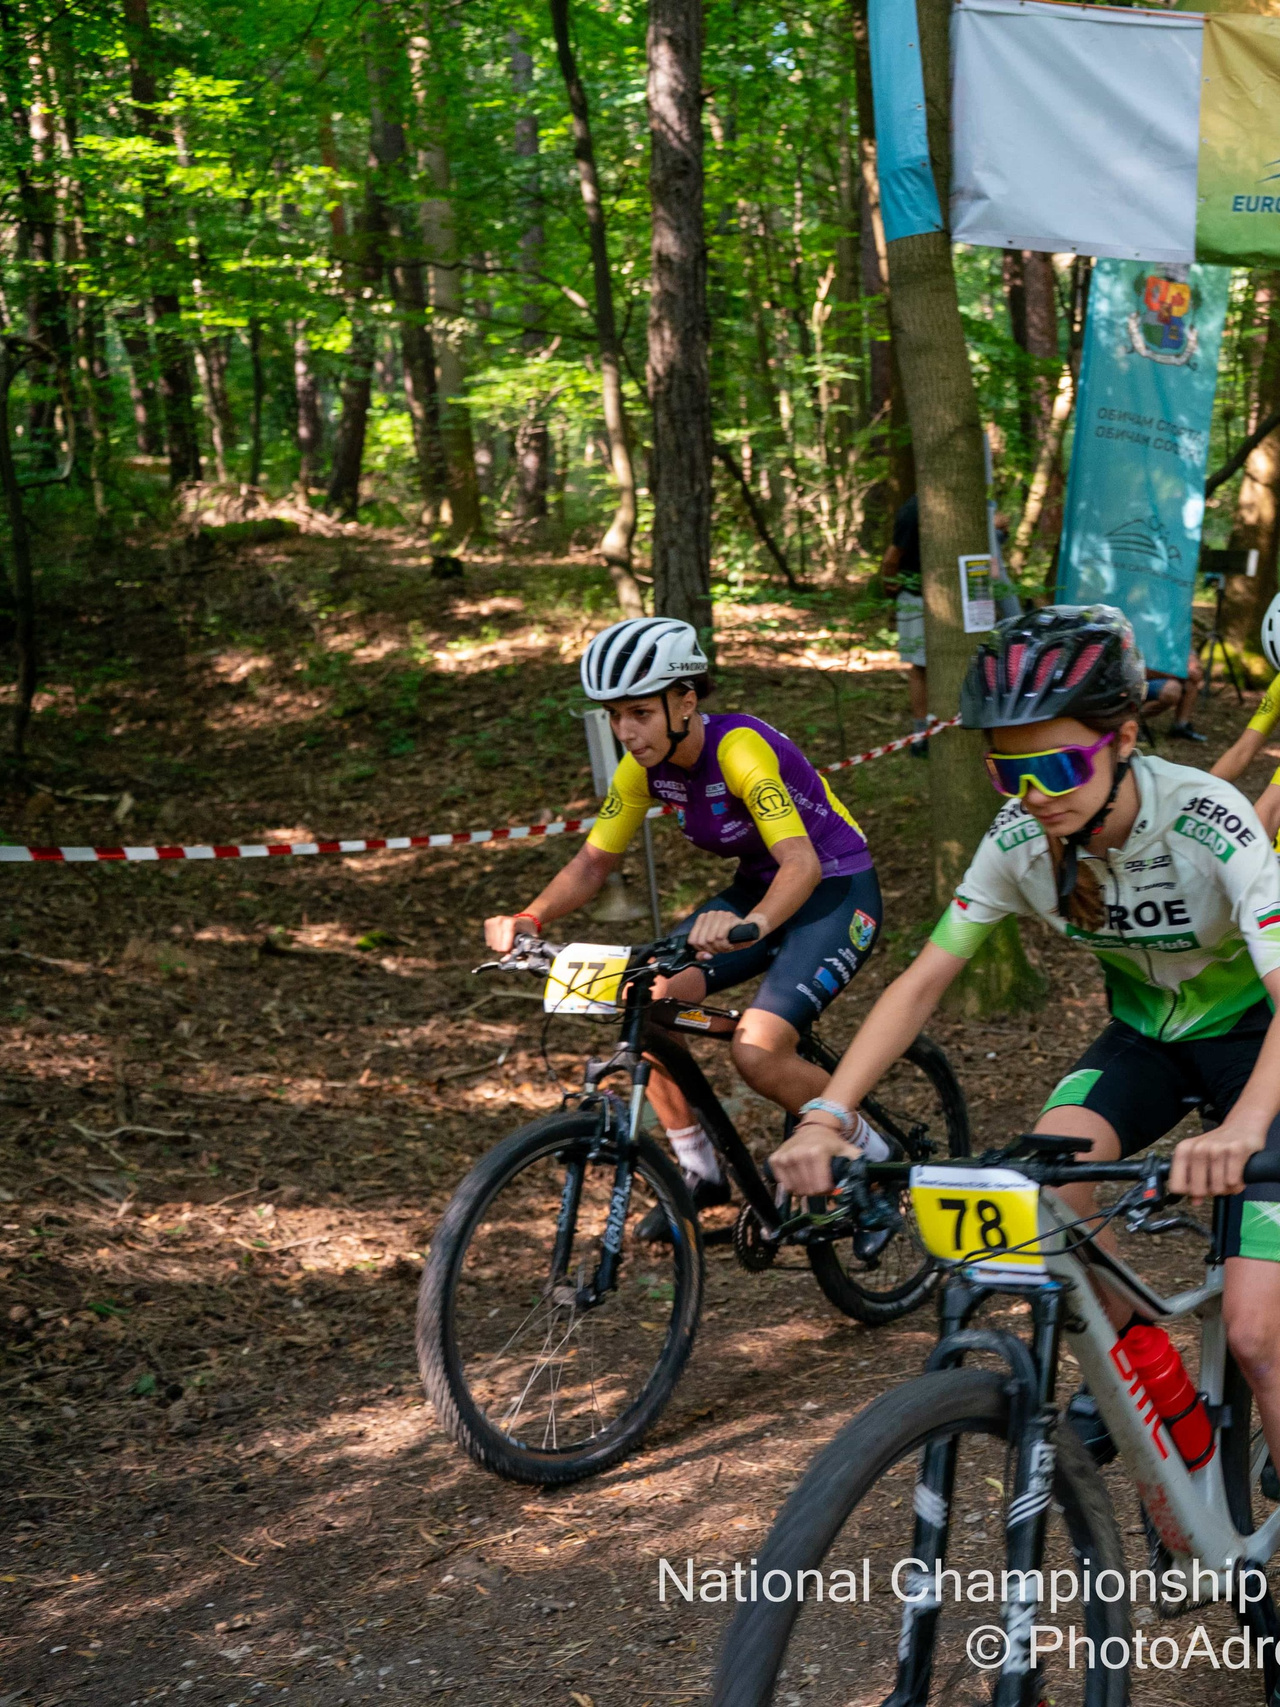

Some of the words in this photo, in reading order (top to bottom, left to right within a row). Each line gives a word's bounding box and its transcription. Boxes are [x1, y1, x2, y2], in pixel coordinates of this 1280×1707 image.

[1183, 820, 1227, 856] ROAD
[1108, 899, 1191, 931] ROE
[567, 962, 607, 995] 77
[938, 1198, 1010, 1251] 78
